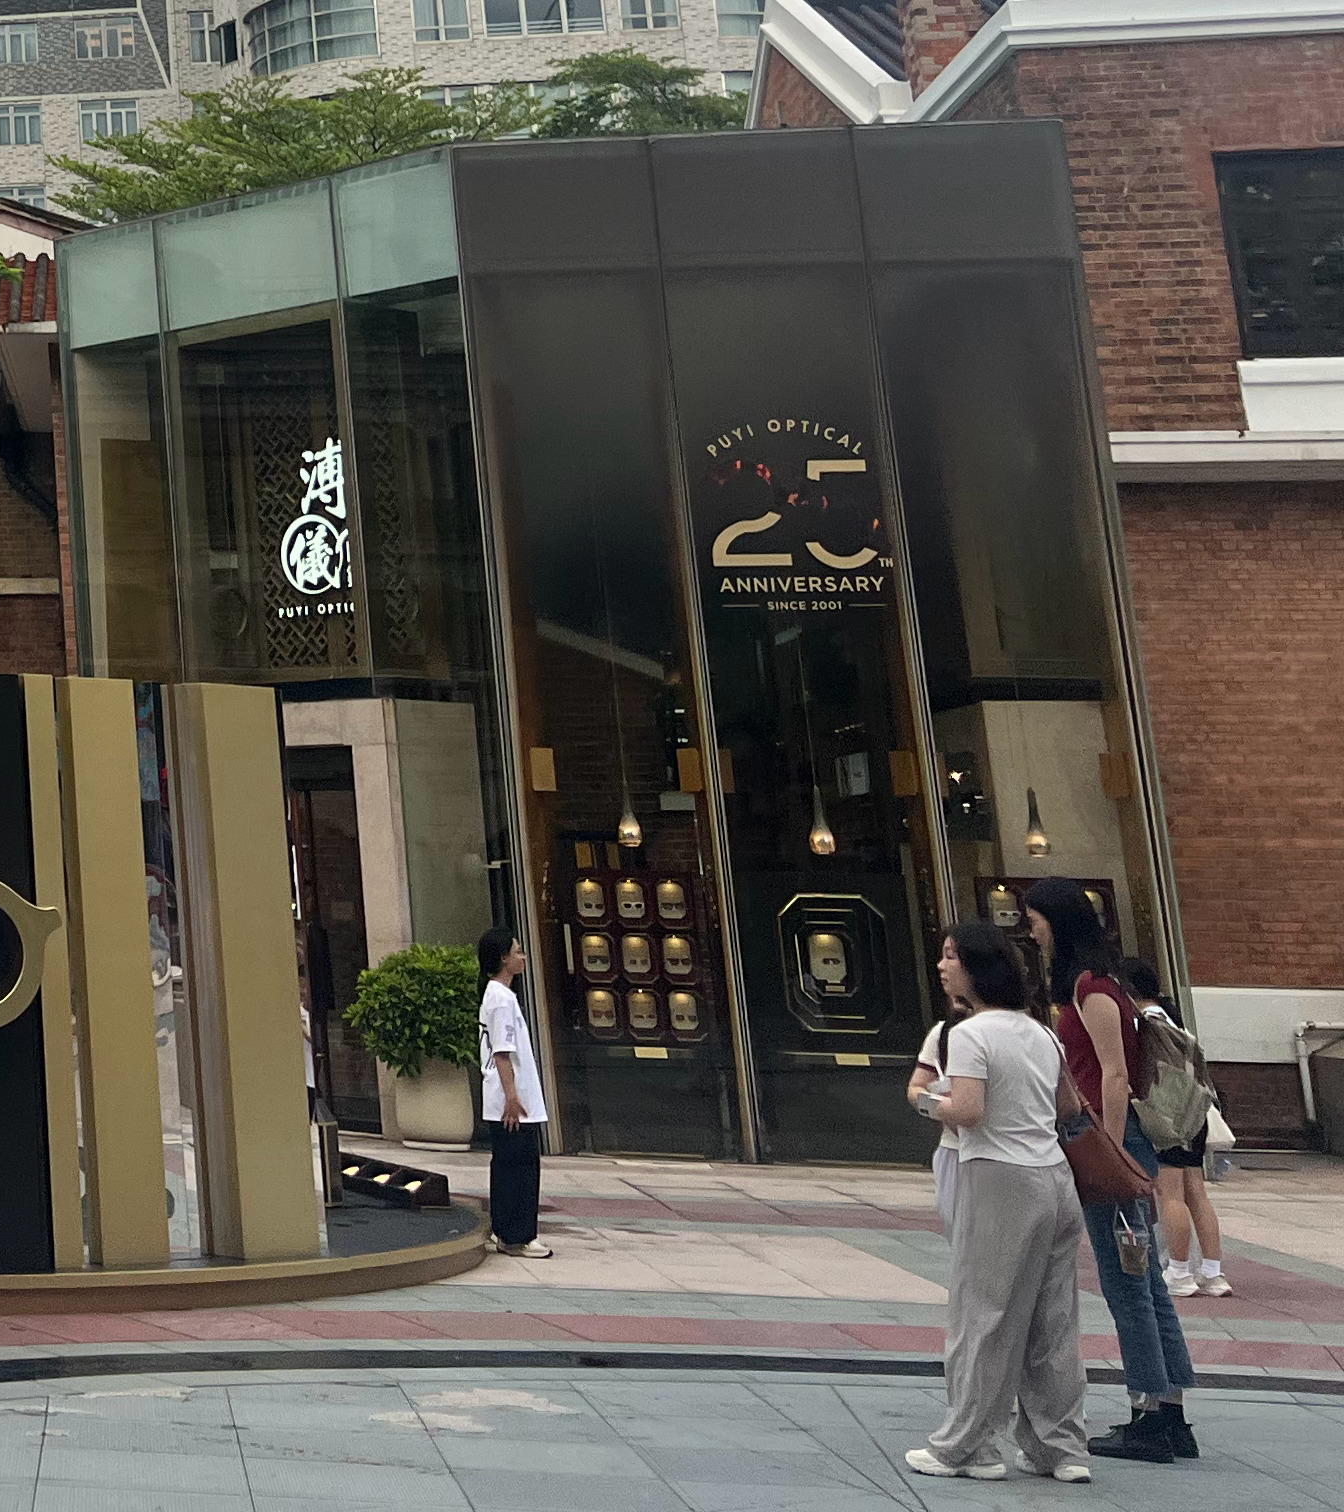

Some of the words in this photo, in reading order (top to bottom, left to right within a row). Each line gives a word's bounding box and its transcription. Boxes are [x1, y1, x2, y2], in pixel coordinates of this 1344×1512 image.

[706, 424, 754, 457] PUYI
[767, 419, 862, 455] OPTICAL
[719, 575, 885, 593] ANNIVERSARY
[278, 604, 309, 619] PUYI
[767, 600, 807, 611] SINCE
[811, 600, 842, 611] 2001
